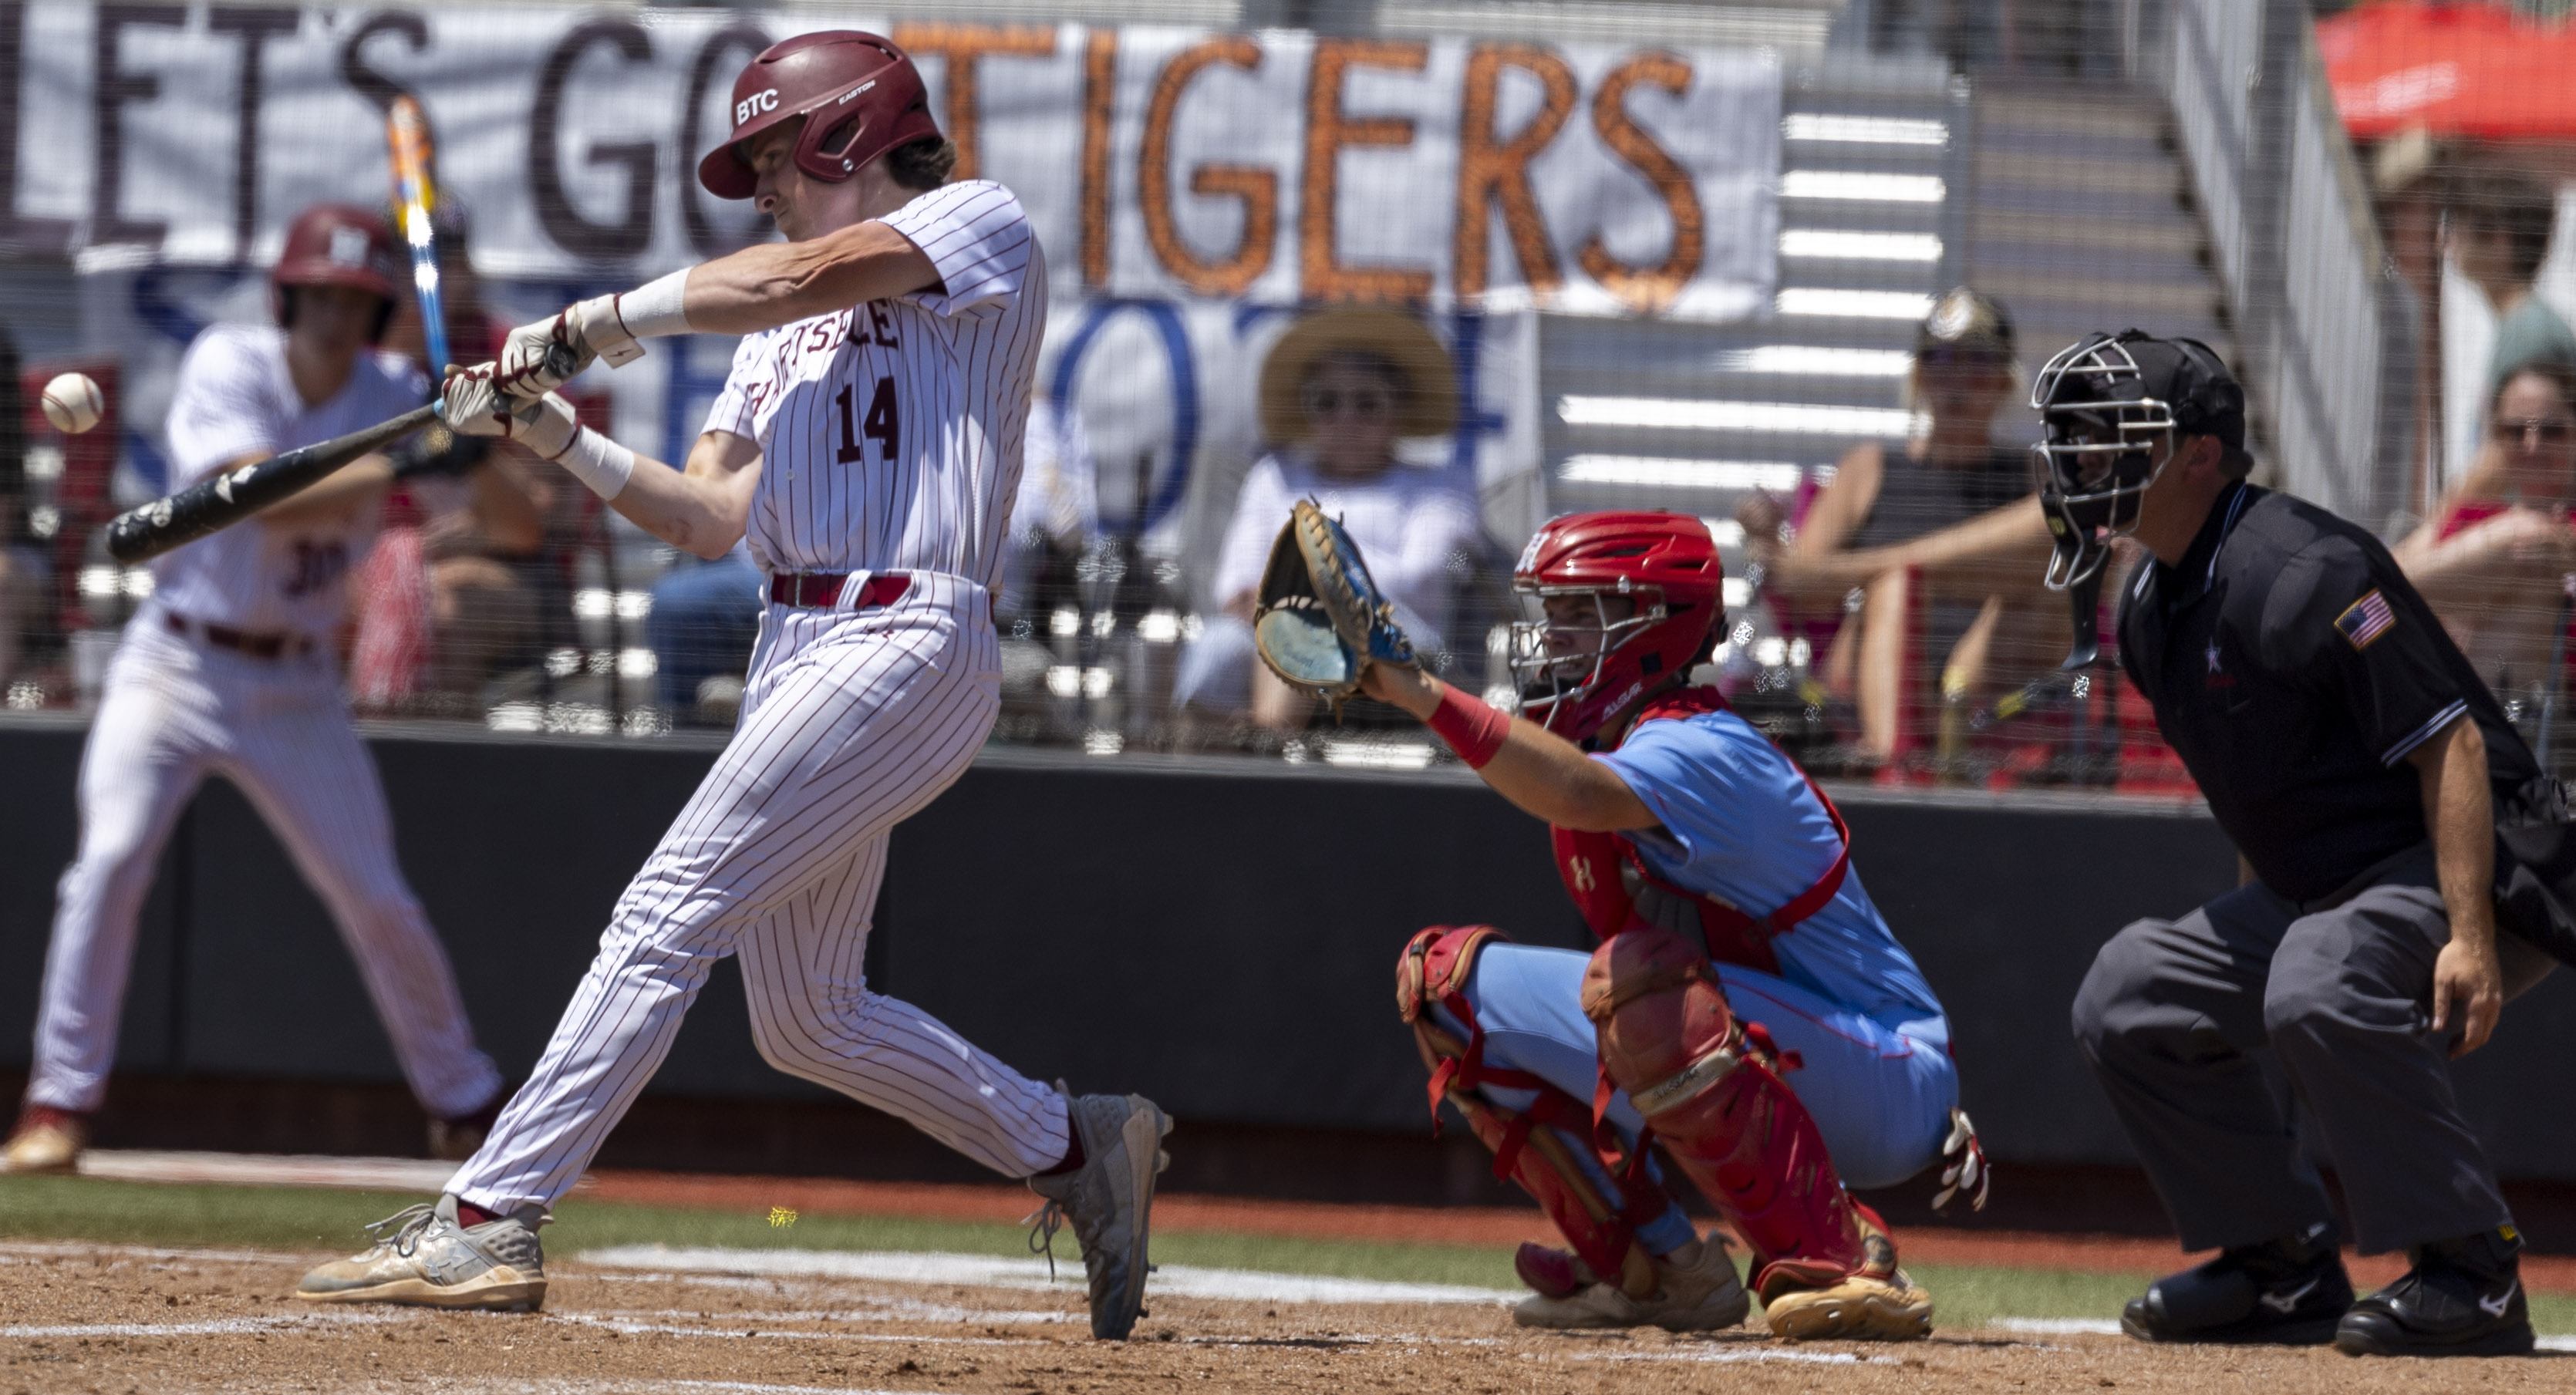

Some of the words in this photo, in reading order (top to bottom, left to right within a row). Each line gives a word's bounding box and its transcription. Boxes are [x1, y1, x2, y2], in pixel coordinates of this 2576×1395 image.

[736, 88, 779, 126] BTC
[838, 79, 876, 106] EASTON
[892, 23, 1706, 310] TIGERS
[835, 375, 899, 466] 14
